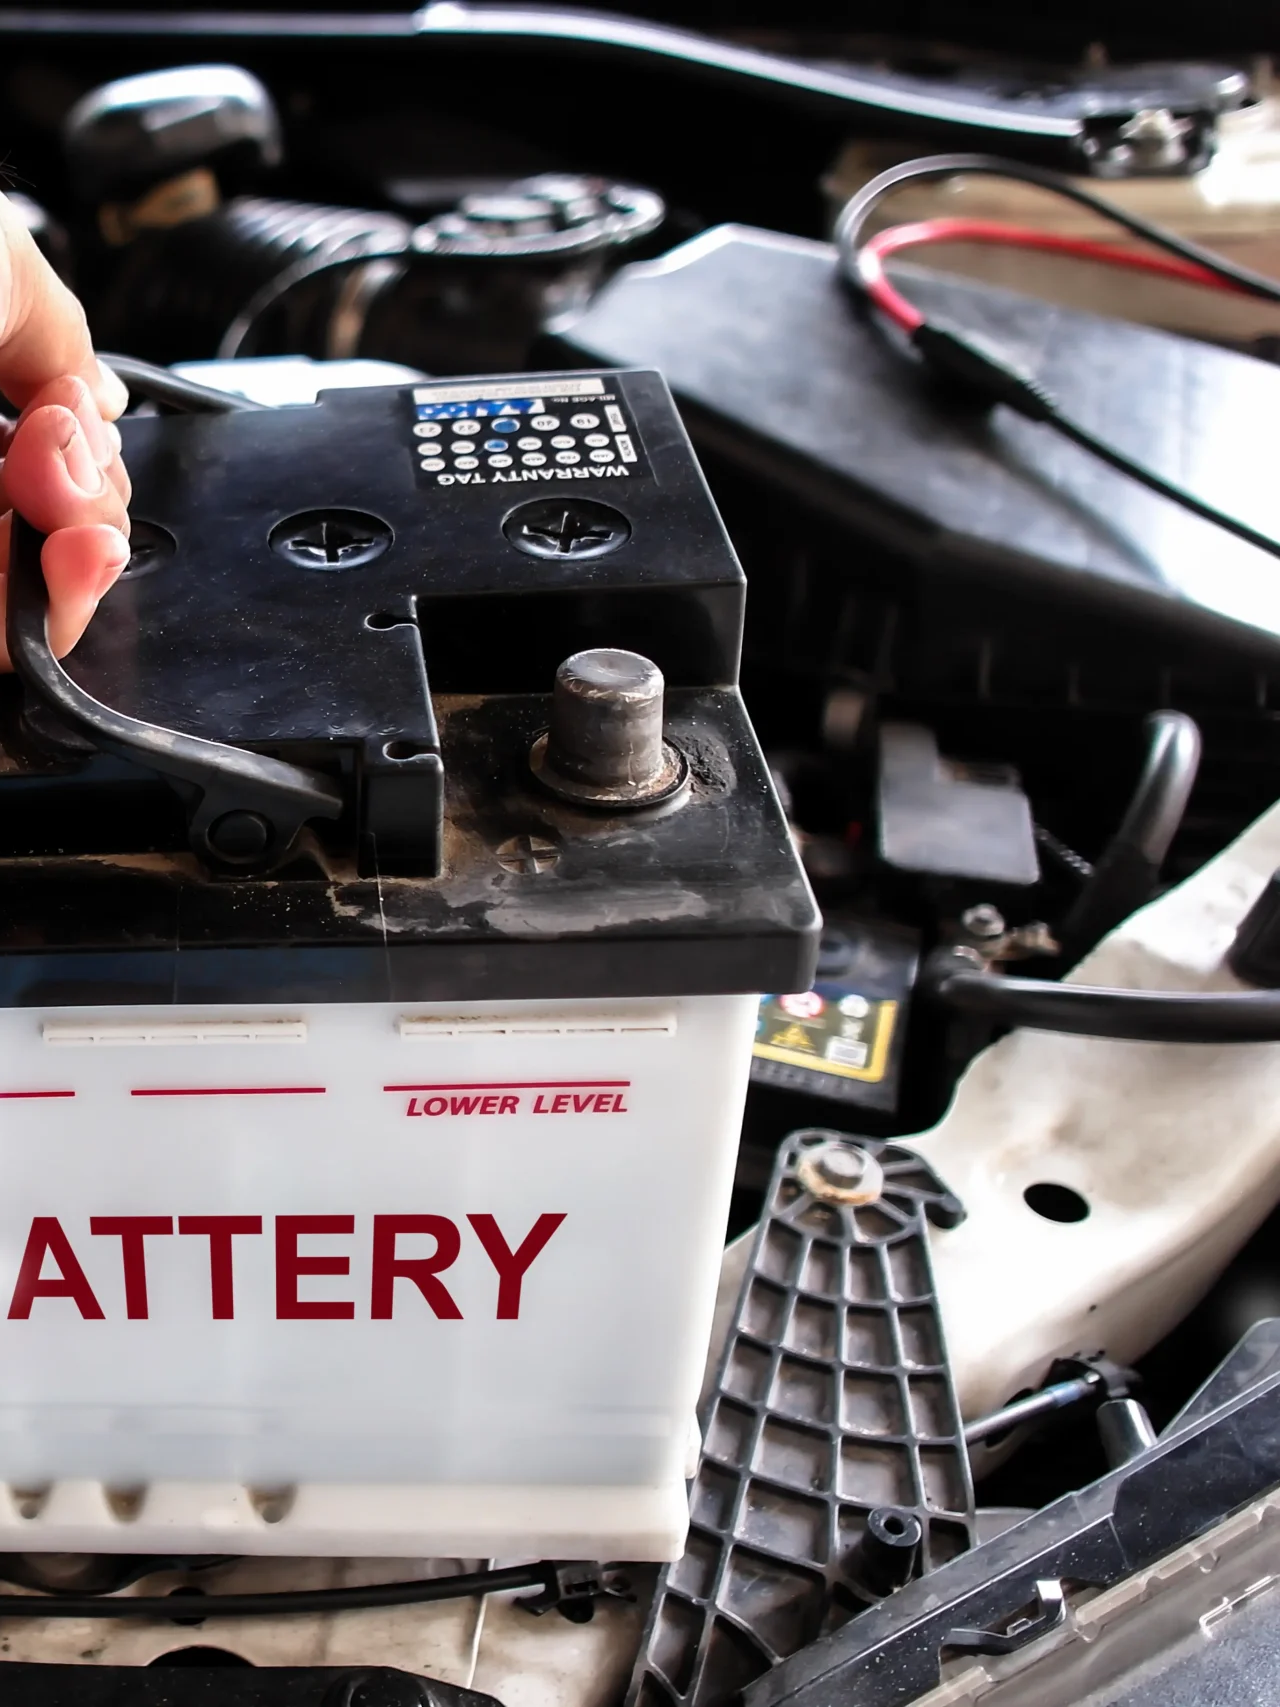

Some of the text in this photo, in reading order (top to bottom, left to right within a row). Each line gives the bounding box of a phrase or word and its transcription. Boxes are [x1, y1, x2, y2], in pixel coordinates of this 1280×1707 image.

[436, 465, 630, 486] WARRANTY TAG
[406, 1093, 628, 1117] LOWER LEVEL
